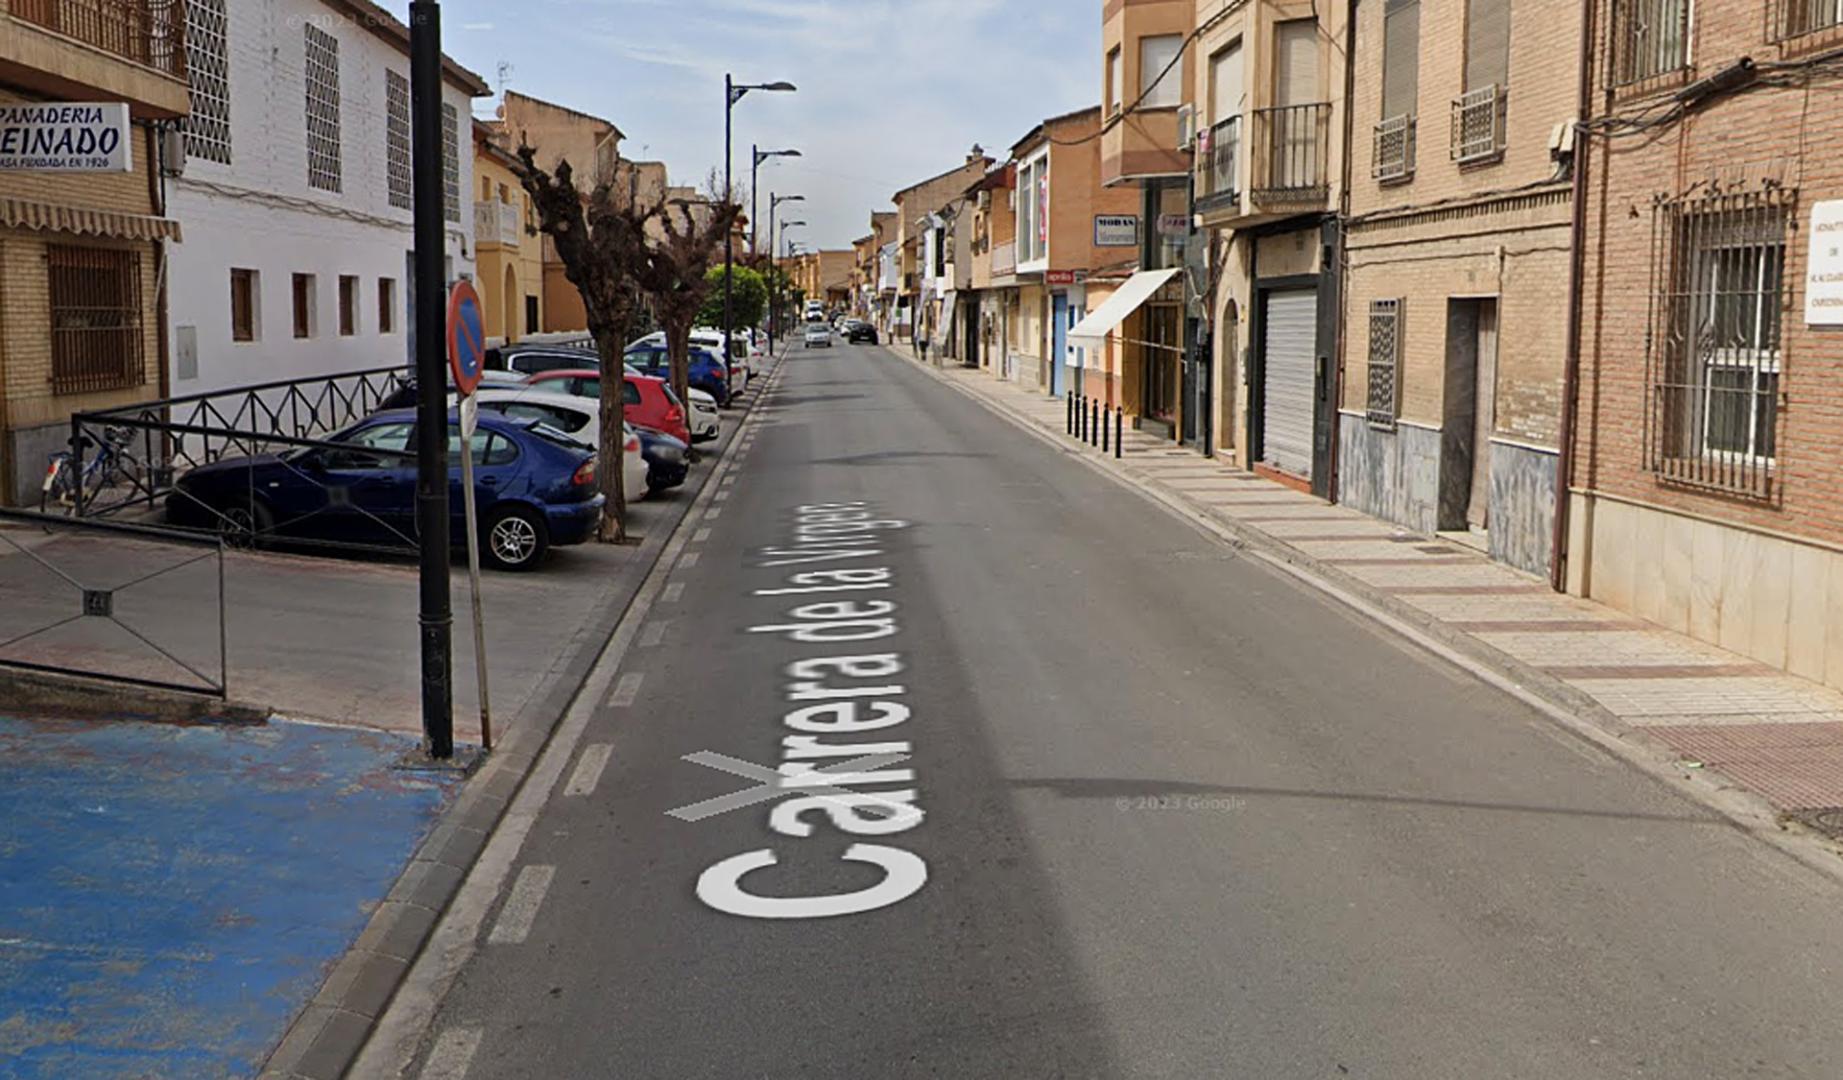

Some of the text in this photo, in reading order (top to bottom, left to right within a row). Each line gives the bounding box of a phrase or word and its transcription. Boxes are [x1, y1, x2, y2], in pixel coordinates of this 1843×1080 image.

[0, 127, 119, 155] EINADO
[20, 157, 66, 168] FUNDADA
[68, 157, 82, 168] EN
[84, 156, 109, 168] 1926
[1098, 218, 1134, 227] MODAS
